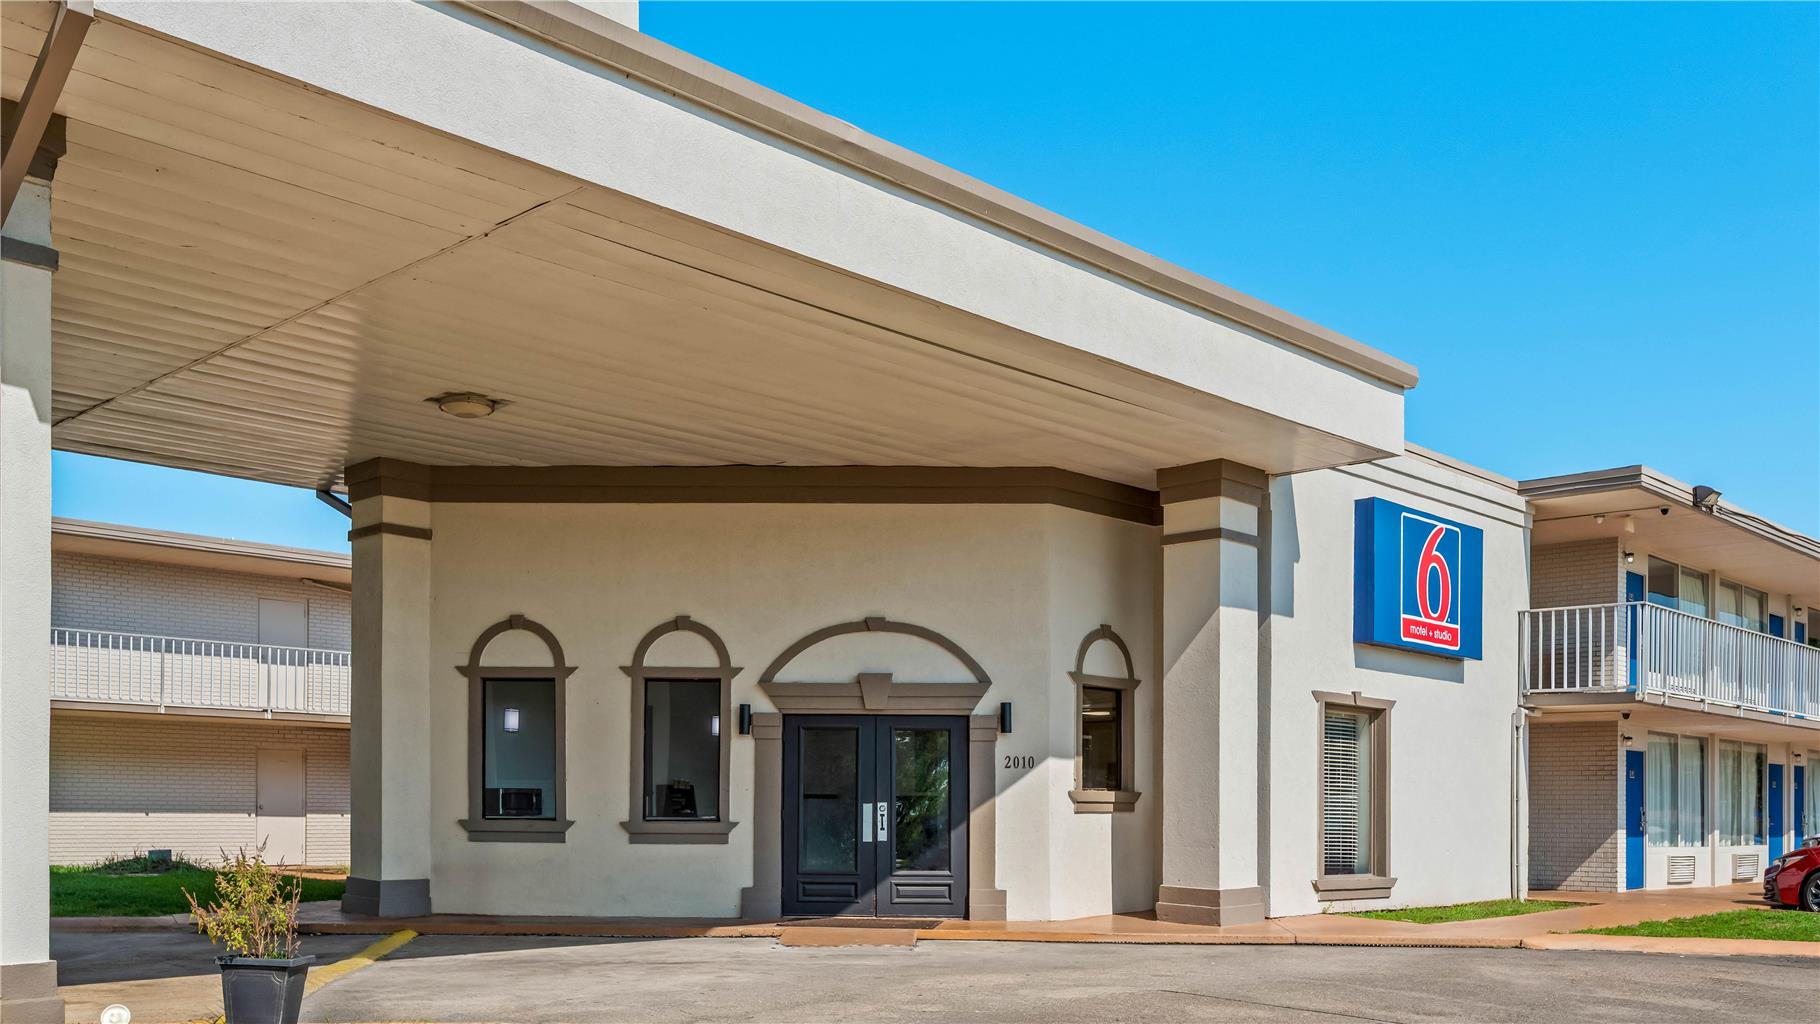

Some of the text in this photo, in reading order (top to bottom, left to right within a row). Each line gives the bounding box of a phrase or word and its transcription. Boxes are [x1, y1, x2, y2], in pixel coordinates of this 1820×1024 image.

[1417, 525, 1451, 623] 6
[1410, 625, 1428, 636] motel
[1434, 629, 1452, 641] studio
[1004, 755, 1035, 769] 2010
